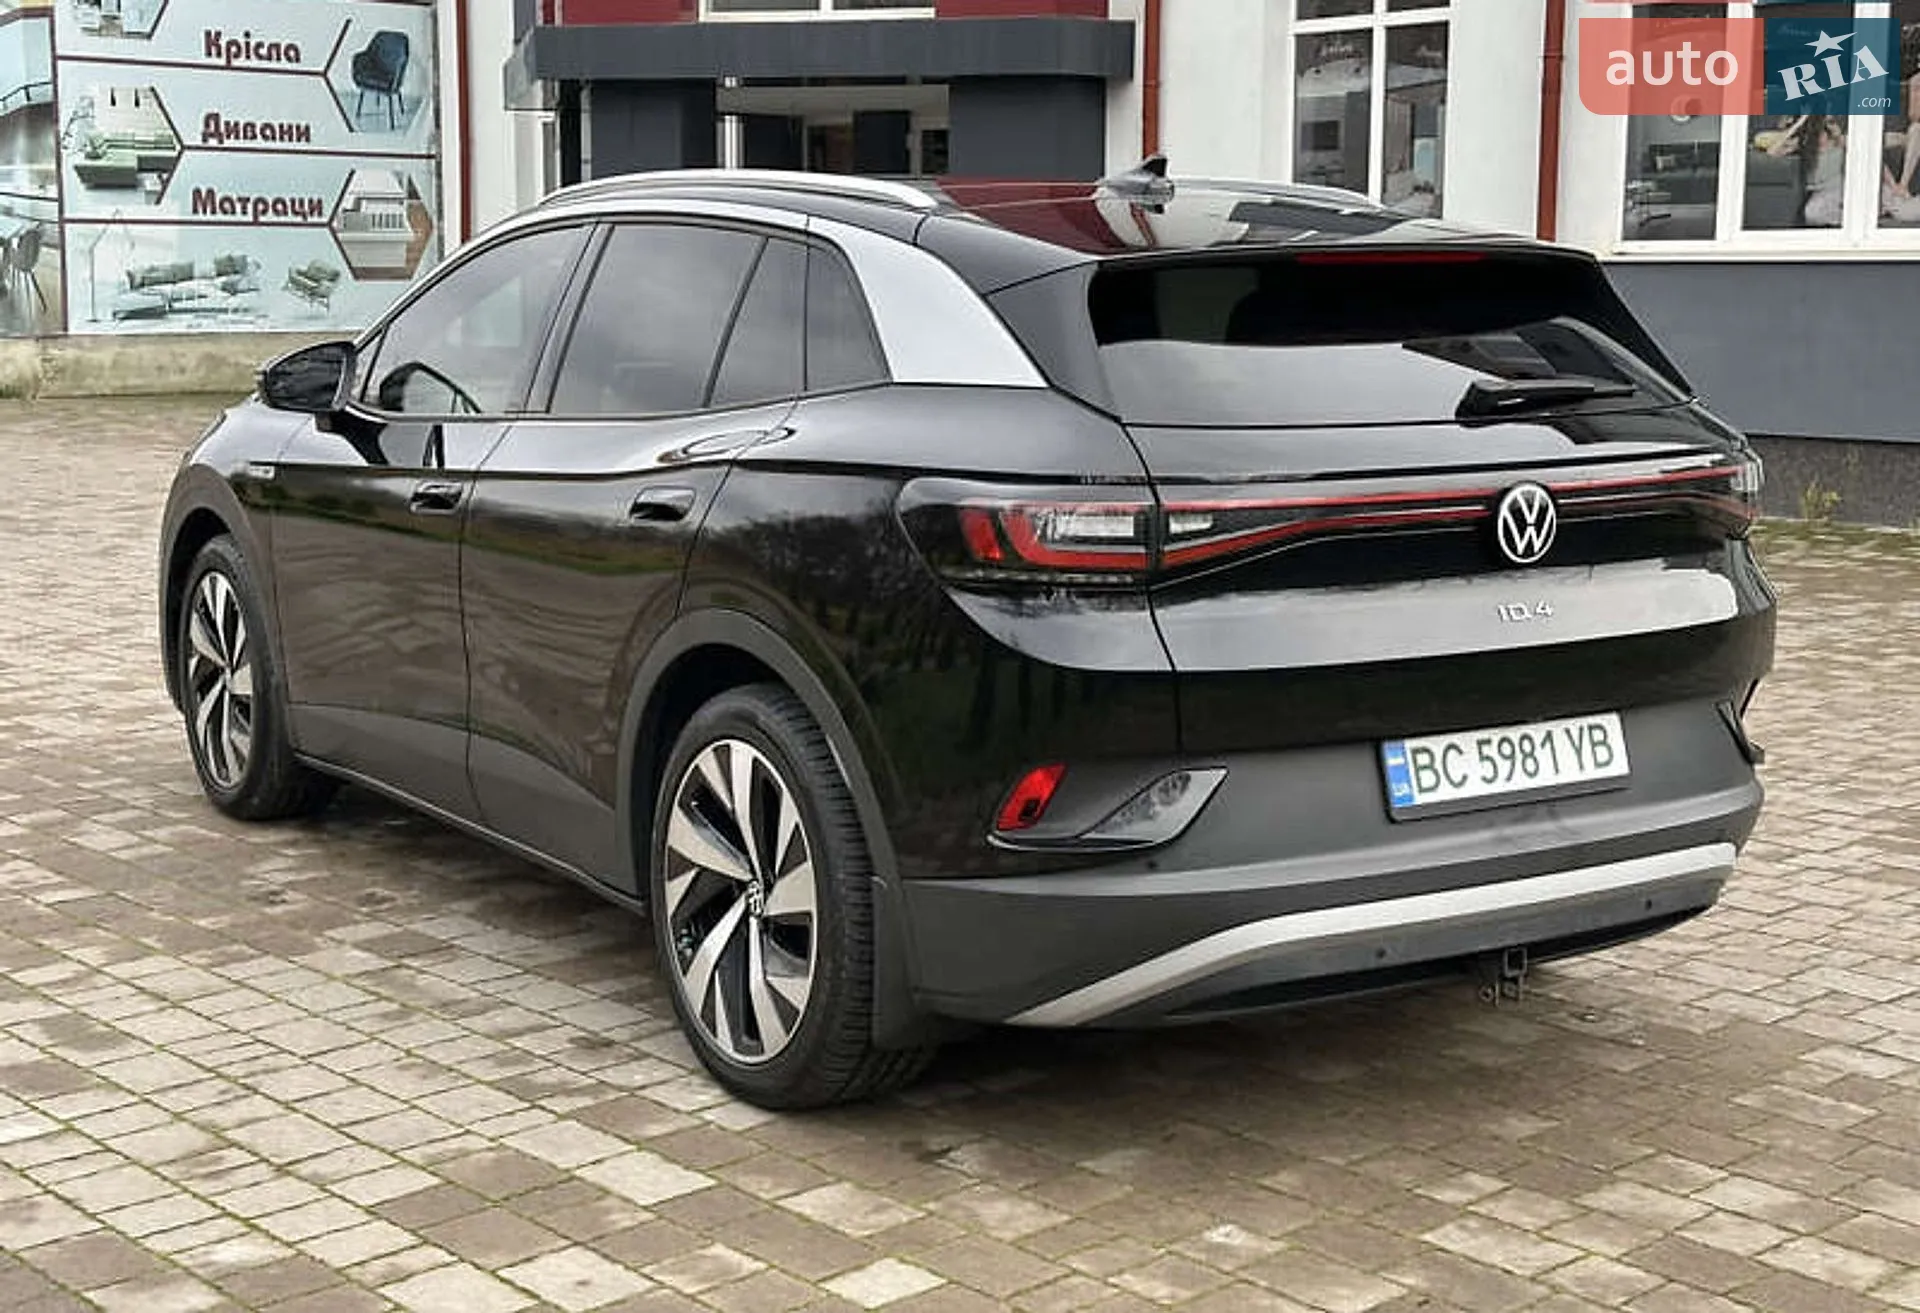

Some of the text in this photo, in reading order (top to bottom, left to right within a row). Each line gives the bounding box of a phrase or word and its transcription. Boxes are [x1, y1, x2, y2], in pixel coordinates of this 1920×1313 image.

[203, 29, 302, 67] Крісла
[201, 111, 312, 145] Дивани
[191, 187, 324, 224] Матраци
[1411, 722, 1615, 794] BC 5981 YB
